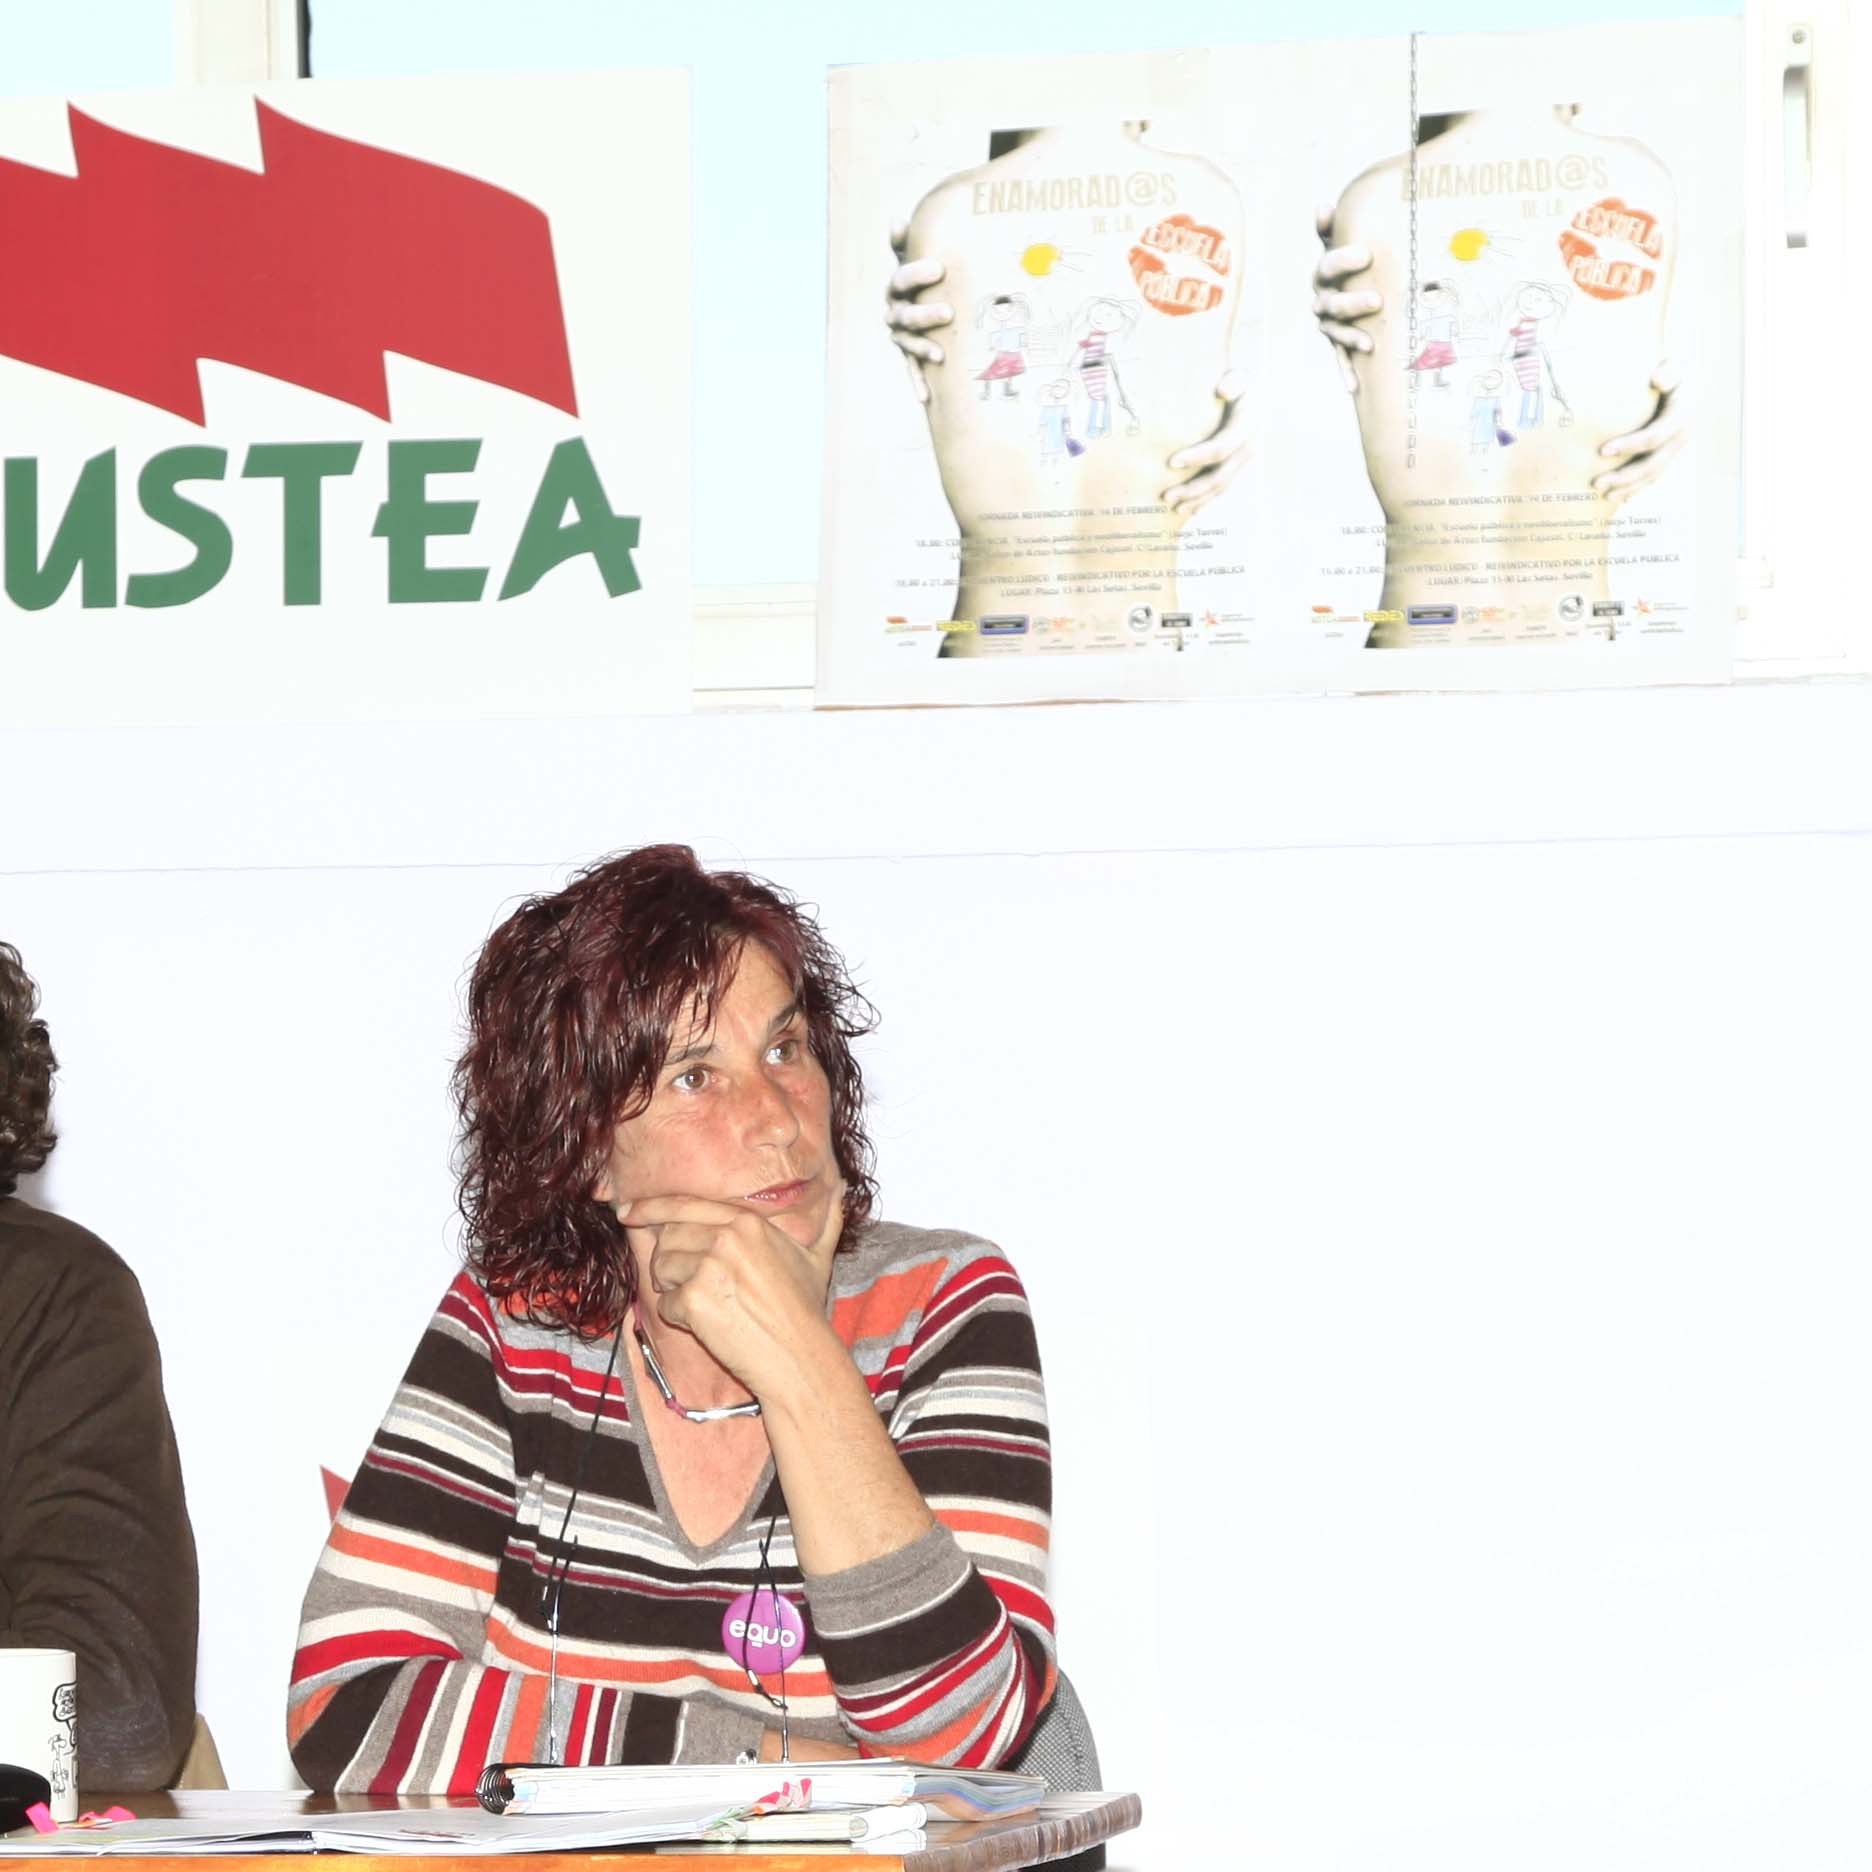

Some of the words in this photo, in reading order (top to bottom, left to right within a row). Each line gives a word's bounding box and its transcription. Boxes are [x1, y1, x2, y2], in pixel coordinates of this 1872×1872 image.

[972, 172, 1177, 216] ENAMORAD@S
[4, 436, 642, 611] USTEA
[729, 1618, 797, 1648] equo
